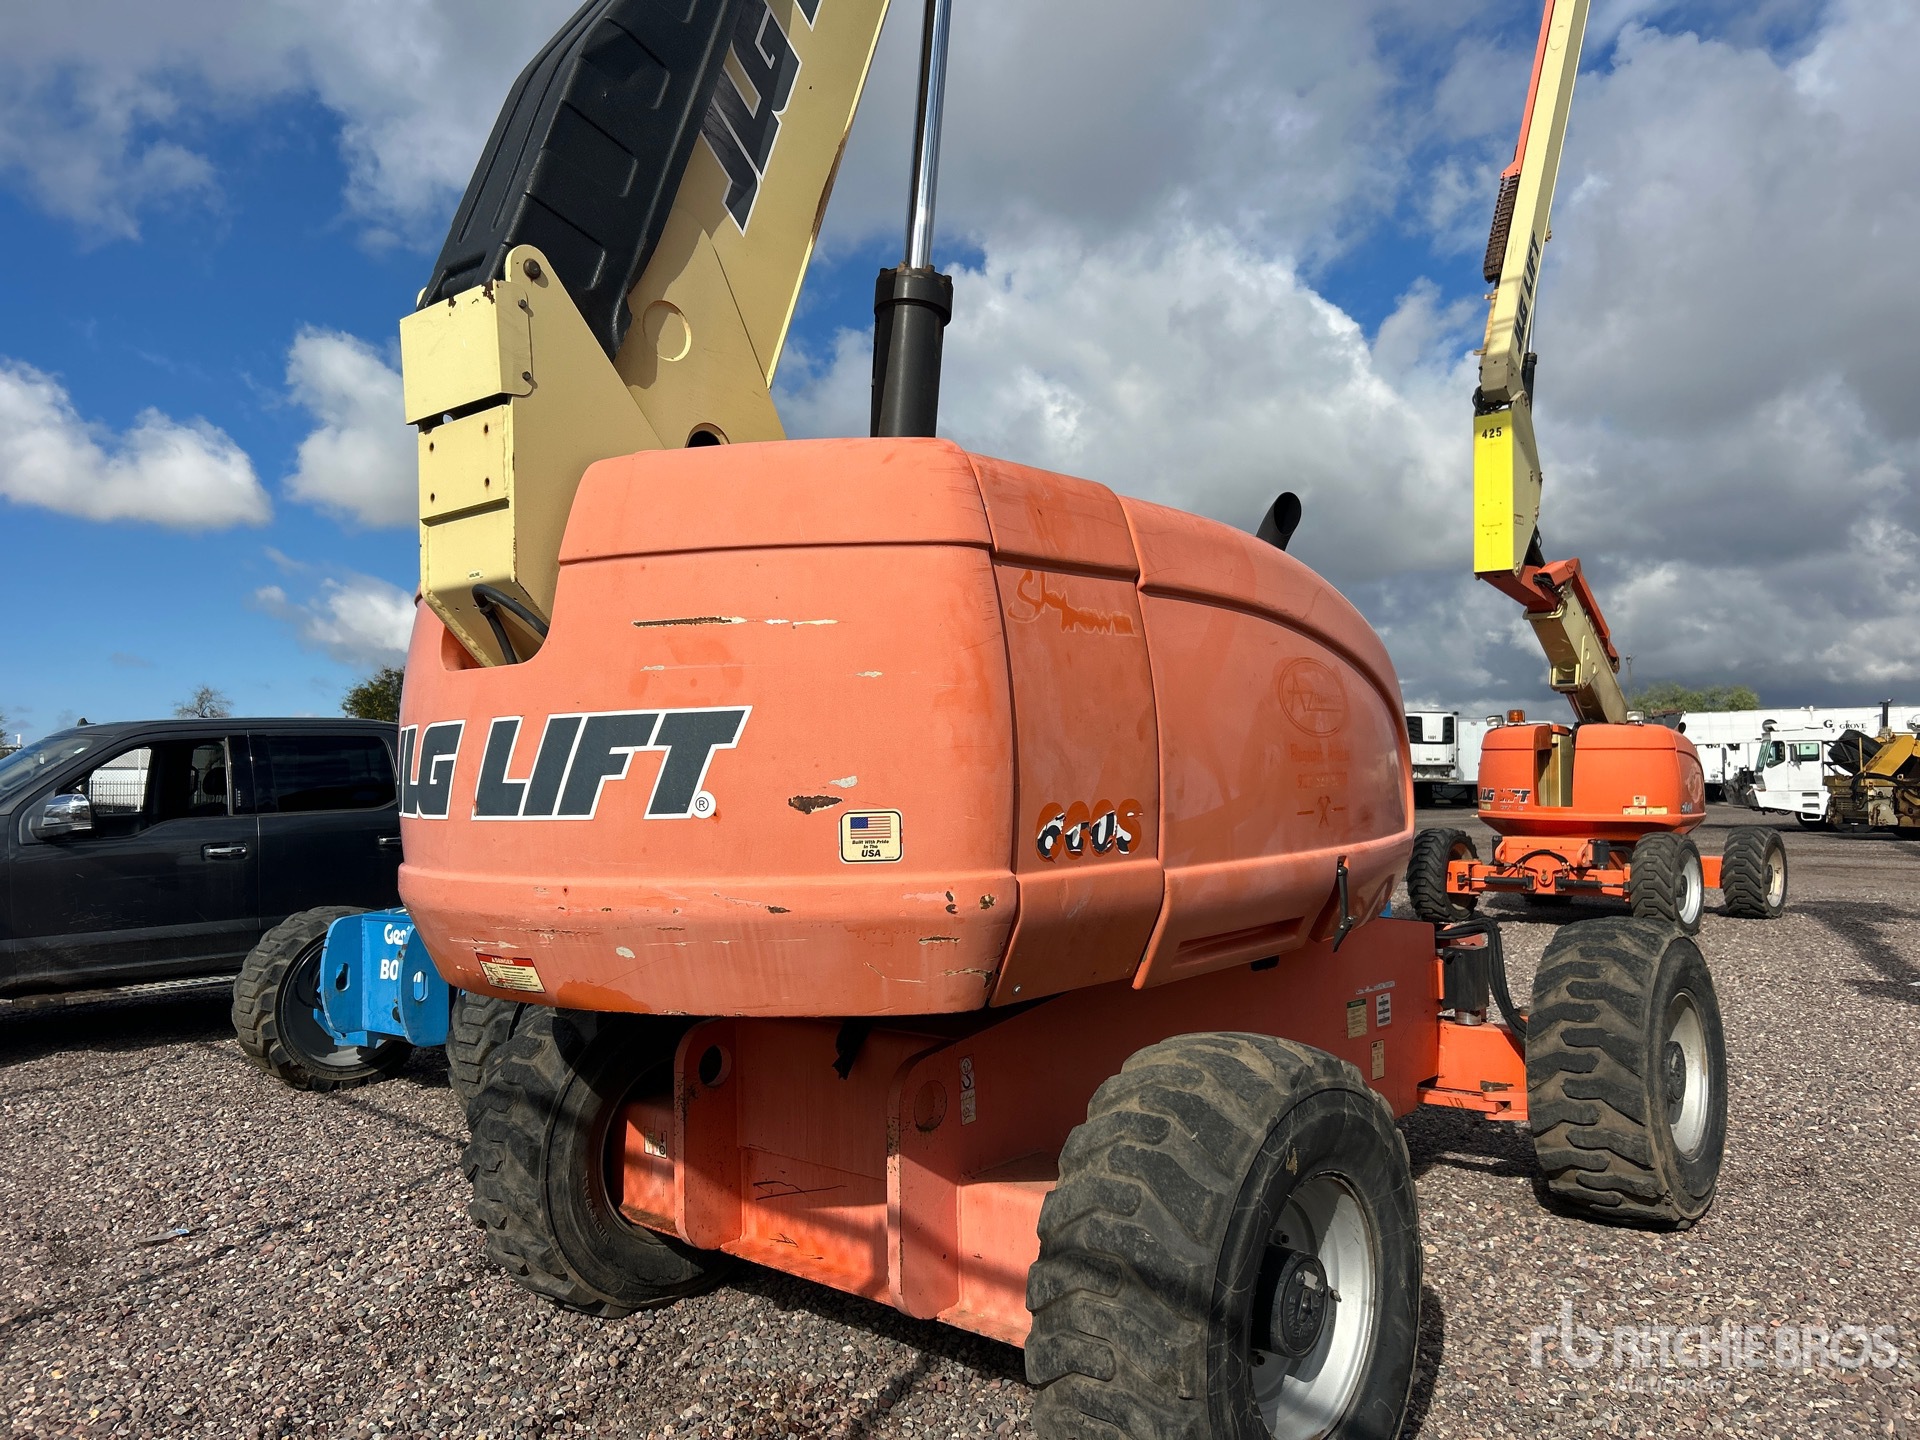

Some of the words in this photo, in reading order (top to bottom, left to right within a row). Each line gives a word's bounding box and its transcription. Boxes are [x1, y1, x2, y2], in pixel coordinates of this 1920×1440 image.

[700, 0, 803, 237] JLG
[1514, 293, 1529, 356] JLG
[1523, 230, 1539, 297] LIFT
[1482, 426, 1503, 439] 425
[471, 704, 753, 821] LIFT
[861, 849, 881, 857] USA
